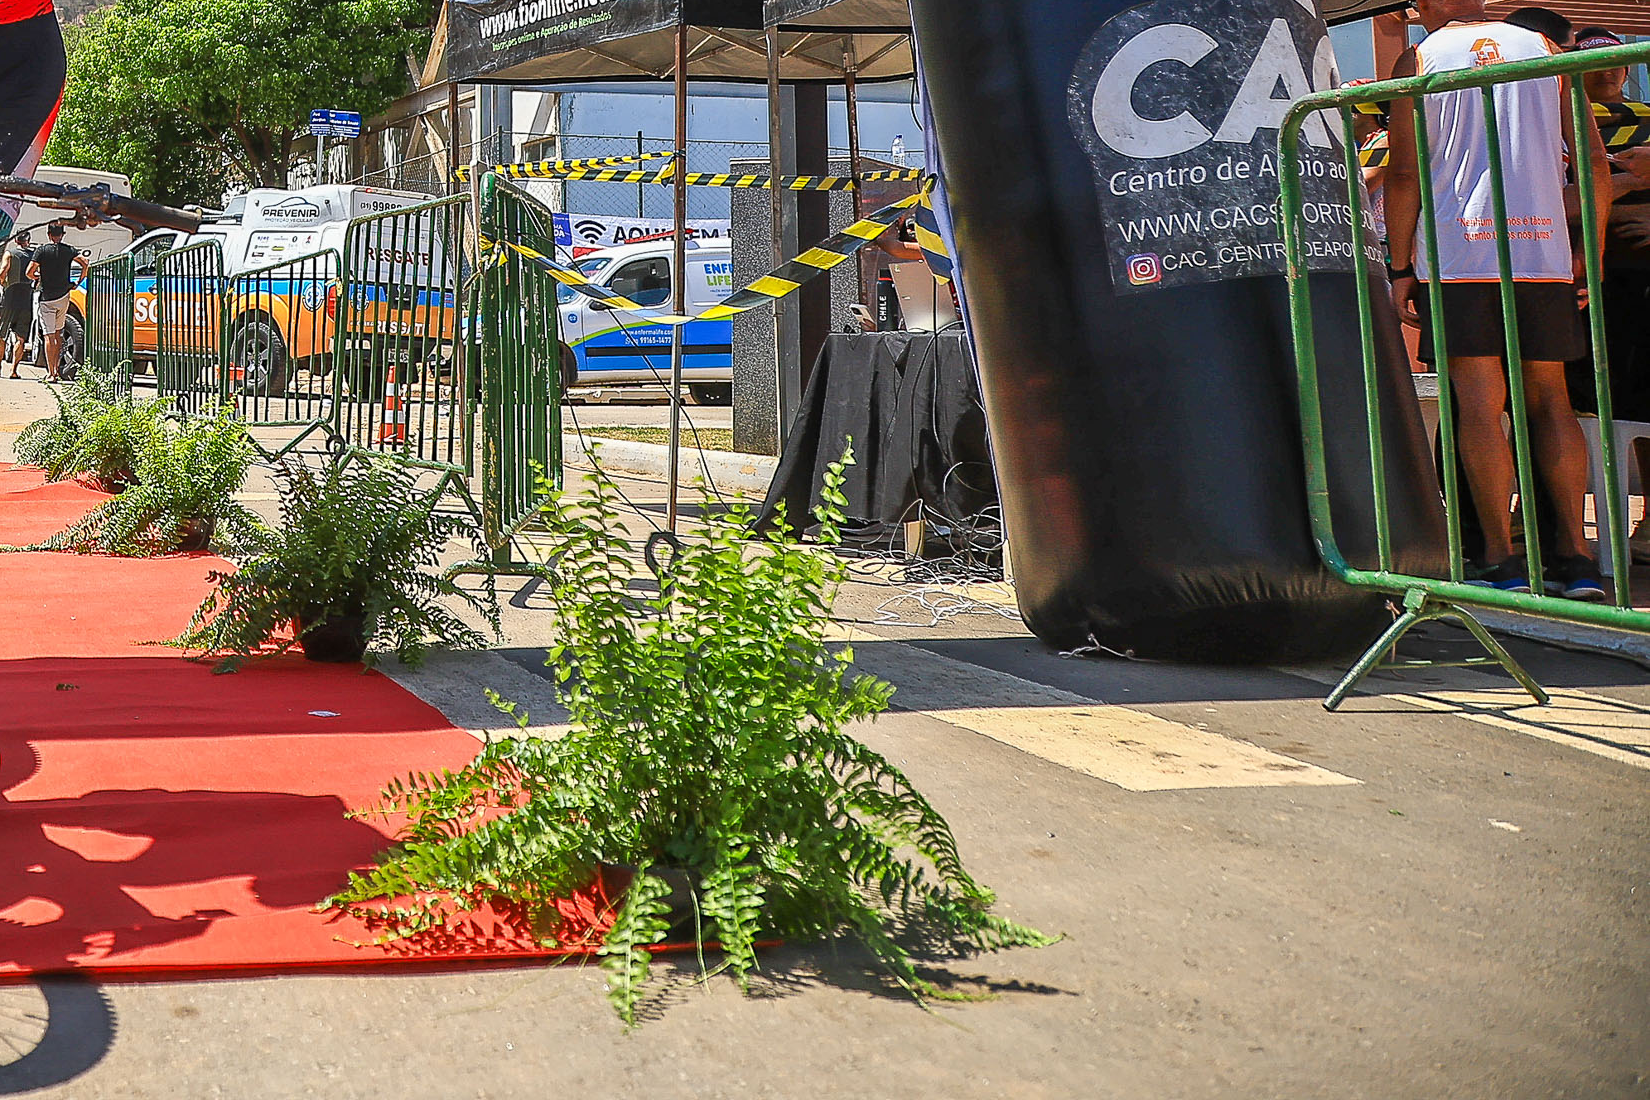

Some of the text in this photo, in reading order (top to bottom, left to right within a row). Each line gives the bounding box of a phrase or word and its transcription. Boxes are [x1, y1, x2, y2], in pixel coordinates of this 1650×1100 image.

[568, 19, 578, 29] de
[1109, 164, 1208, 197] Centro
[1216, 155, 1250, 181] de
[262, 209, 319, 218] PREVENIR
[879, 295, 887, 321] CHILE
